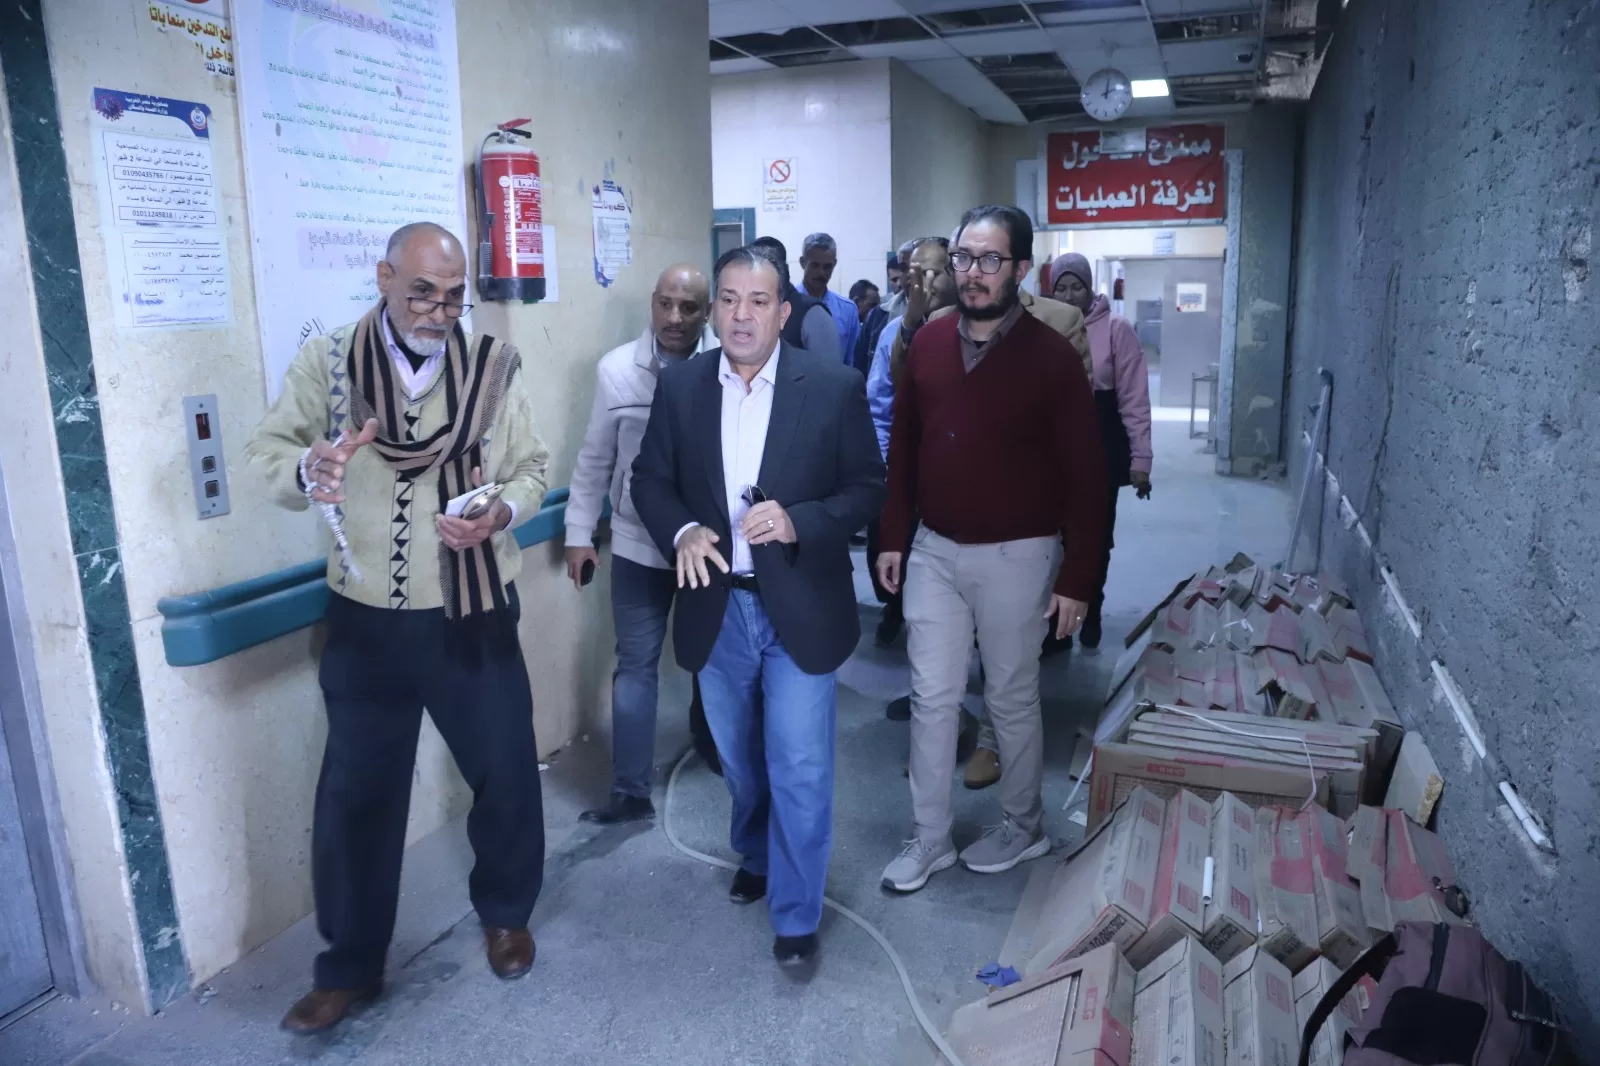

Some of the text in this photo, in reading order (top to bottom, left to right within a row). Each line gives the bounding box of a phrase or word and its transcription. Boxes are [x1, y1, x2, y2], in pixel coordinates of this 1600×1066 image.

[187, 18, 219, 37] التدخين
[206, 46, 233, 62] داخل
[1148, 133, 1212, 166] ممنوع
[1055, 179, 1216, 217] لغرفة العمليات
